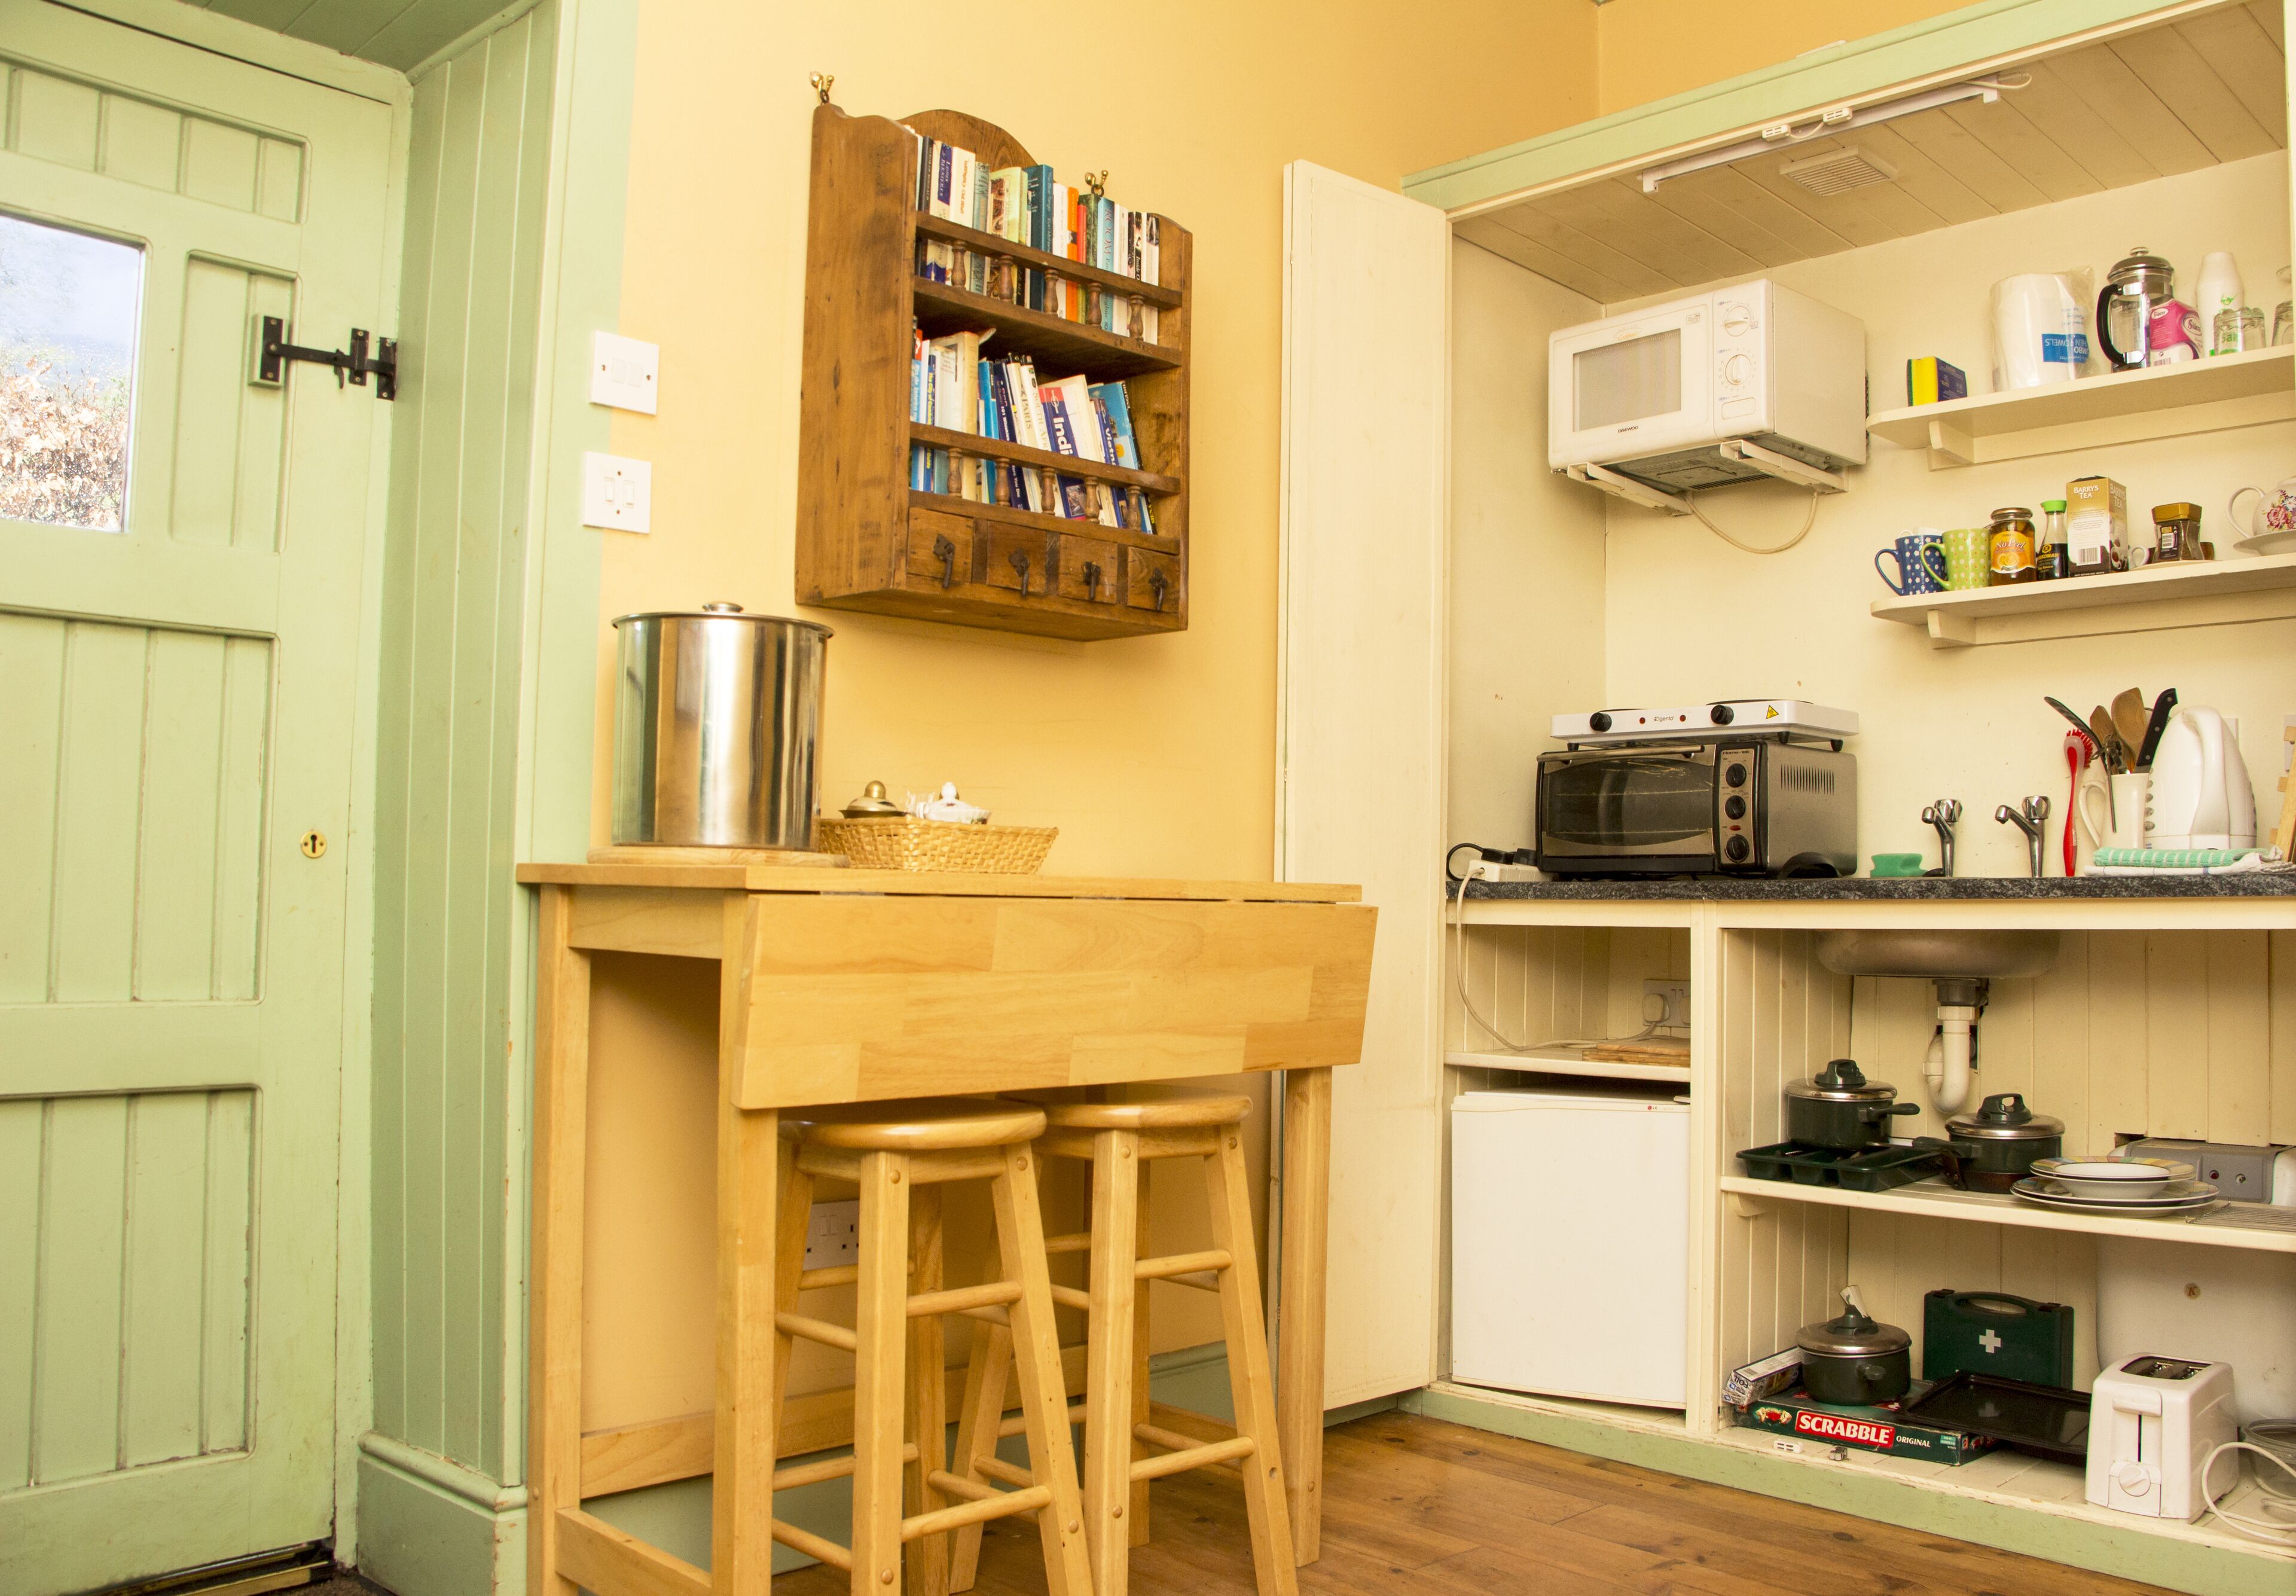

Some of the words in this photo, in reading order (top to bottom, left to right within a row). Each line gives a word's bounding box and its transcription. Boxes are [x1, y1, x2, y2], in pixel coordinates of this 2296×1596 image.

[1104, 209, 1113, 254] ROOM
[1022, 398, 1032, 429] PARIS
[1617, 425, 1639, 434] DAEWOO
[2114, 496, 2123, 509] TEA
[1996, 540, 2007, 548] No
[2008, 539, 2026, 549] Peel
[1733, 1375, 1749, 1389] FOIL
[1799, 1415, 1891, 1445] SCRABBLE
[1896, 1435, 1931, 1448] ORIGINAL
